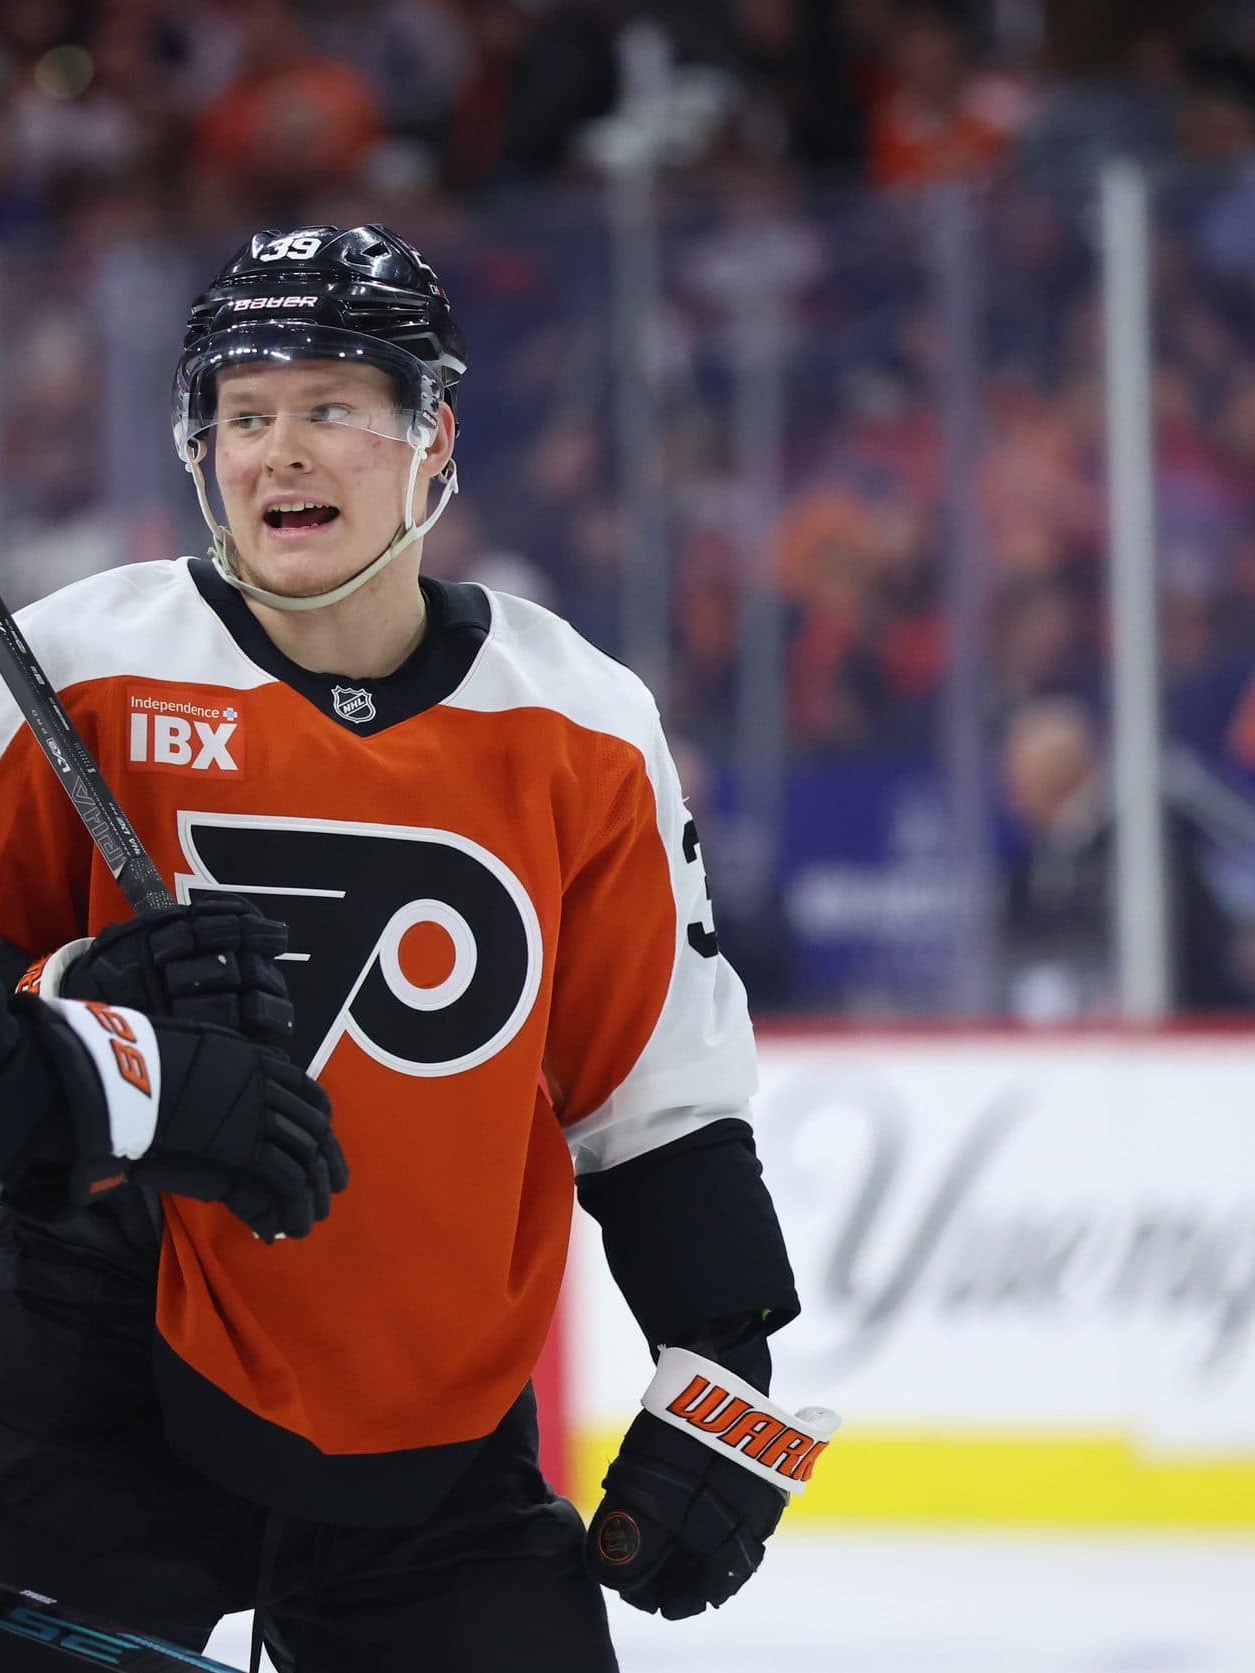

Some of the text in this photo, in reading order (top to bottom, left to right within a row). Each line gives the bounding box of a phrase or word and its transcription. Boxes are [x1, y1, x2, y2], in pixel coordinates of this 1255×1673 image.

[259, 237, 322, 261] 39
[233, 296, 318, 311] BAUER
[131, 695, 220, 719] Independence
[342, 698, 365, 714] NHL
[129, 712, 239, 771] IBX
